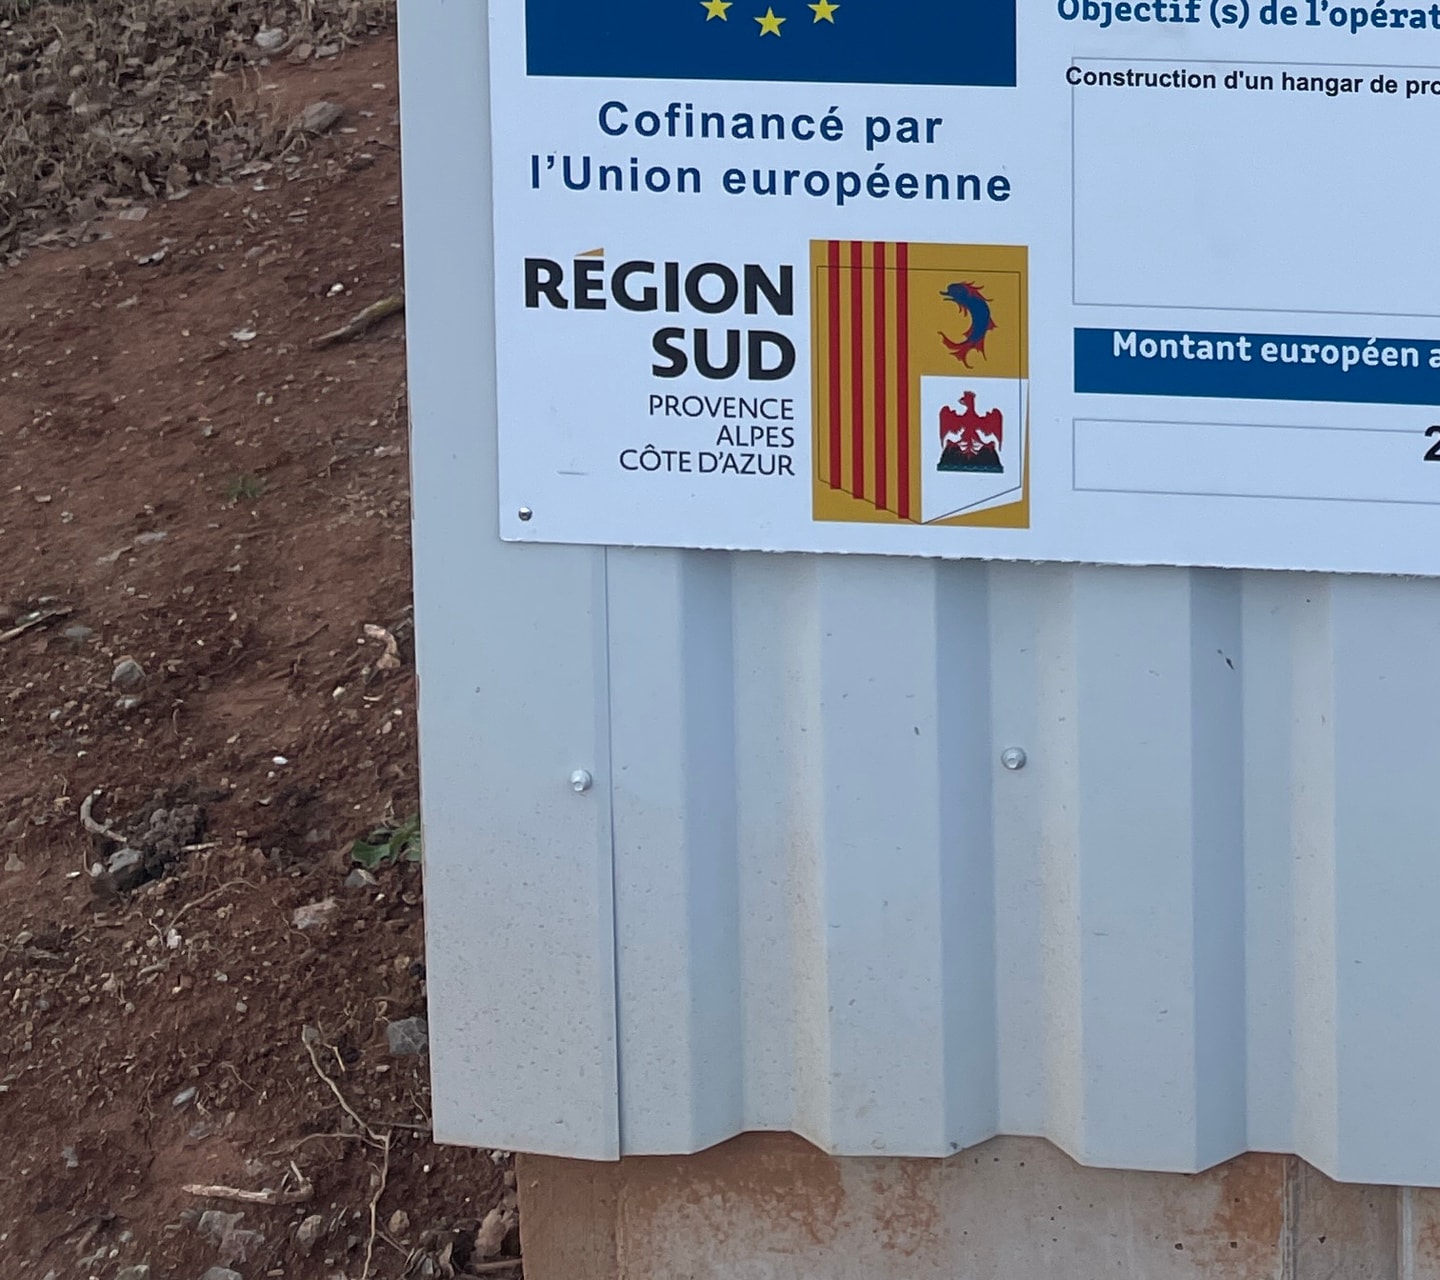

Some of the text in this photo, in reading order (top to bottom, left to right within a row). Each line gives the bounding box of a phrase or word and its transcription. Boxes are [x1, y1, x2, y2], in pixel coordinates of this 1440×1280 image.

[1065, 66, 1216, 89] Construction
[1224, 70, 1274, 91] d'un
[1281, 71, 1364, 97] hangar
[1369, 74, 1398, 94] de
[598, 100, 943, 152] Cofinancé par
[722, 162, 1011, 206] européenne
[524, 248, 794, 316] RÉGION
[651, 326, 796, 381] SUD
[1113, 331, 1253, 362] Montant
[1260, 339, 1420, 372] européen
[649, 394, 794, 421] PROVENCE
[716, 425, 795, 449] ALPES
[619, 443, 692, 474] CÔTE
